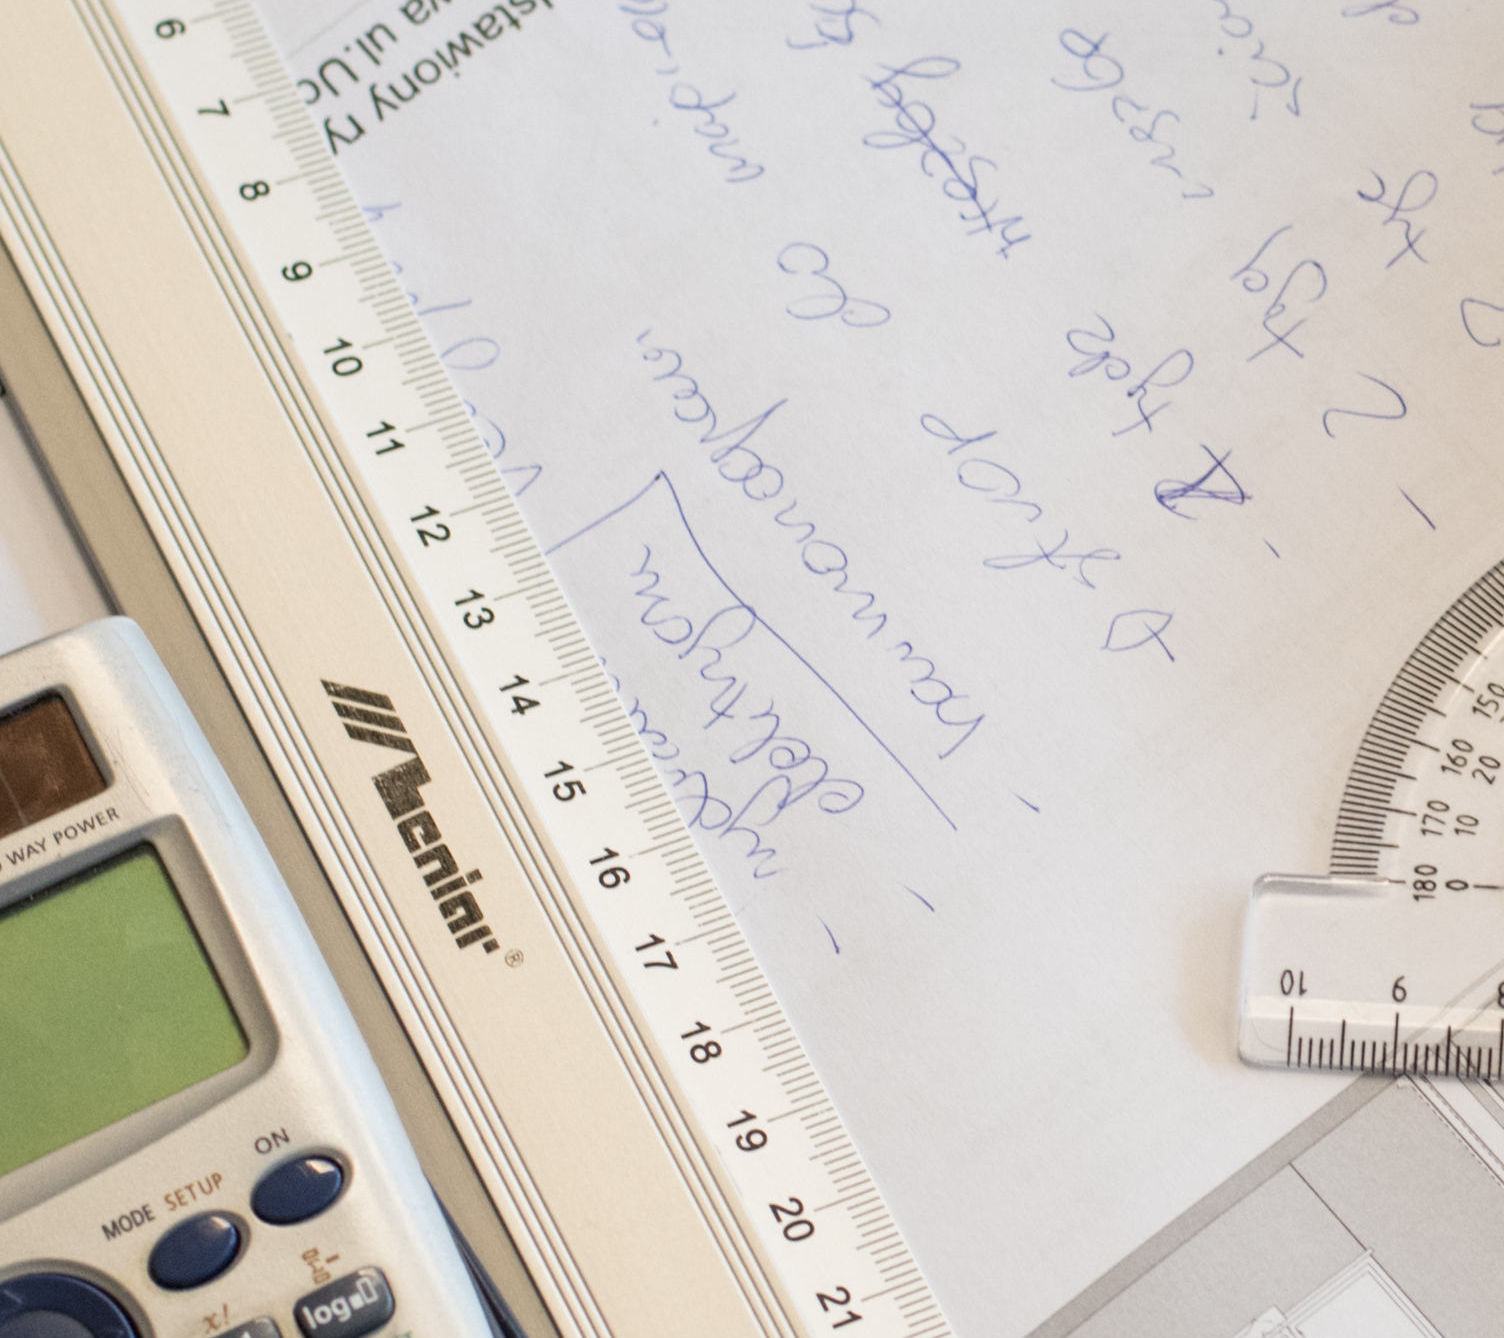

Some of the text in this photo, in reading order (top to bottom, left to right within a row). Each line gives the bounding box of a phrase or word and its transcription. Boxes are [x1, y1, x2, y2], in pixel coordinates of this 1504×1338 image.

[155, 17, 186, 42] 6
[238, 179, 271, 203] 8
[322, 336, 365, 378] 10
[409, 504, 453, 548] 12
[499, 674, 541, 716] 14
[1440, 737, 1476, 777] 160
[544, 760, 587, 802] 15
[6, 838, 49, 868] WAY
[52, 807, 121, 847] POWER
[1420, 799, 1451, 838] 170
[587, 846, 632, 891] 16
[1413, 864, 1438, 903] 180
[1445, 877, 1470, 893] 0
[634, 932, 679, 974] 17
[1280, 970, 1308, 998] 10
[680, 1020, 724, 1064] 18
[253, 1127, 291, 1155] ON
[726, 1109, 770, 1153] 19
[100, 1171, 224, 1241] MODE SETUP
[767, 1196, 816, 1243] 20
